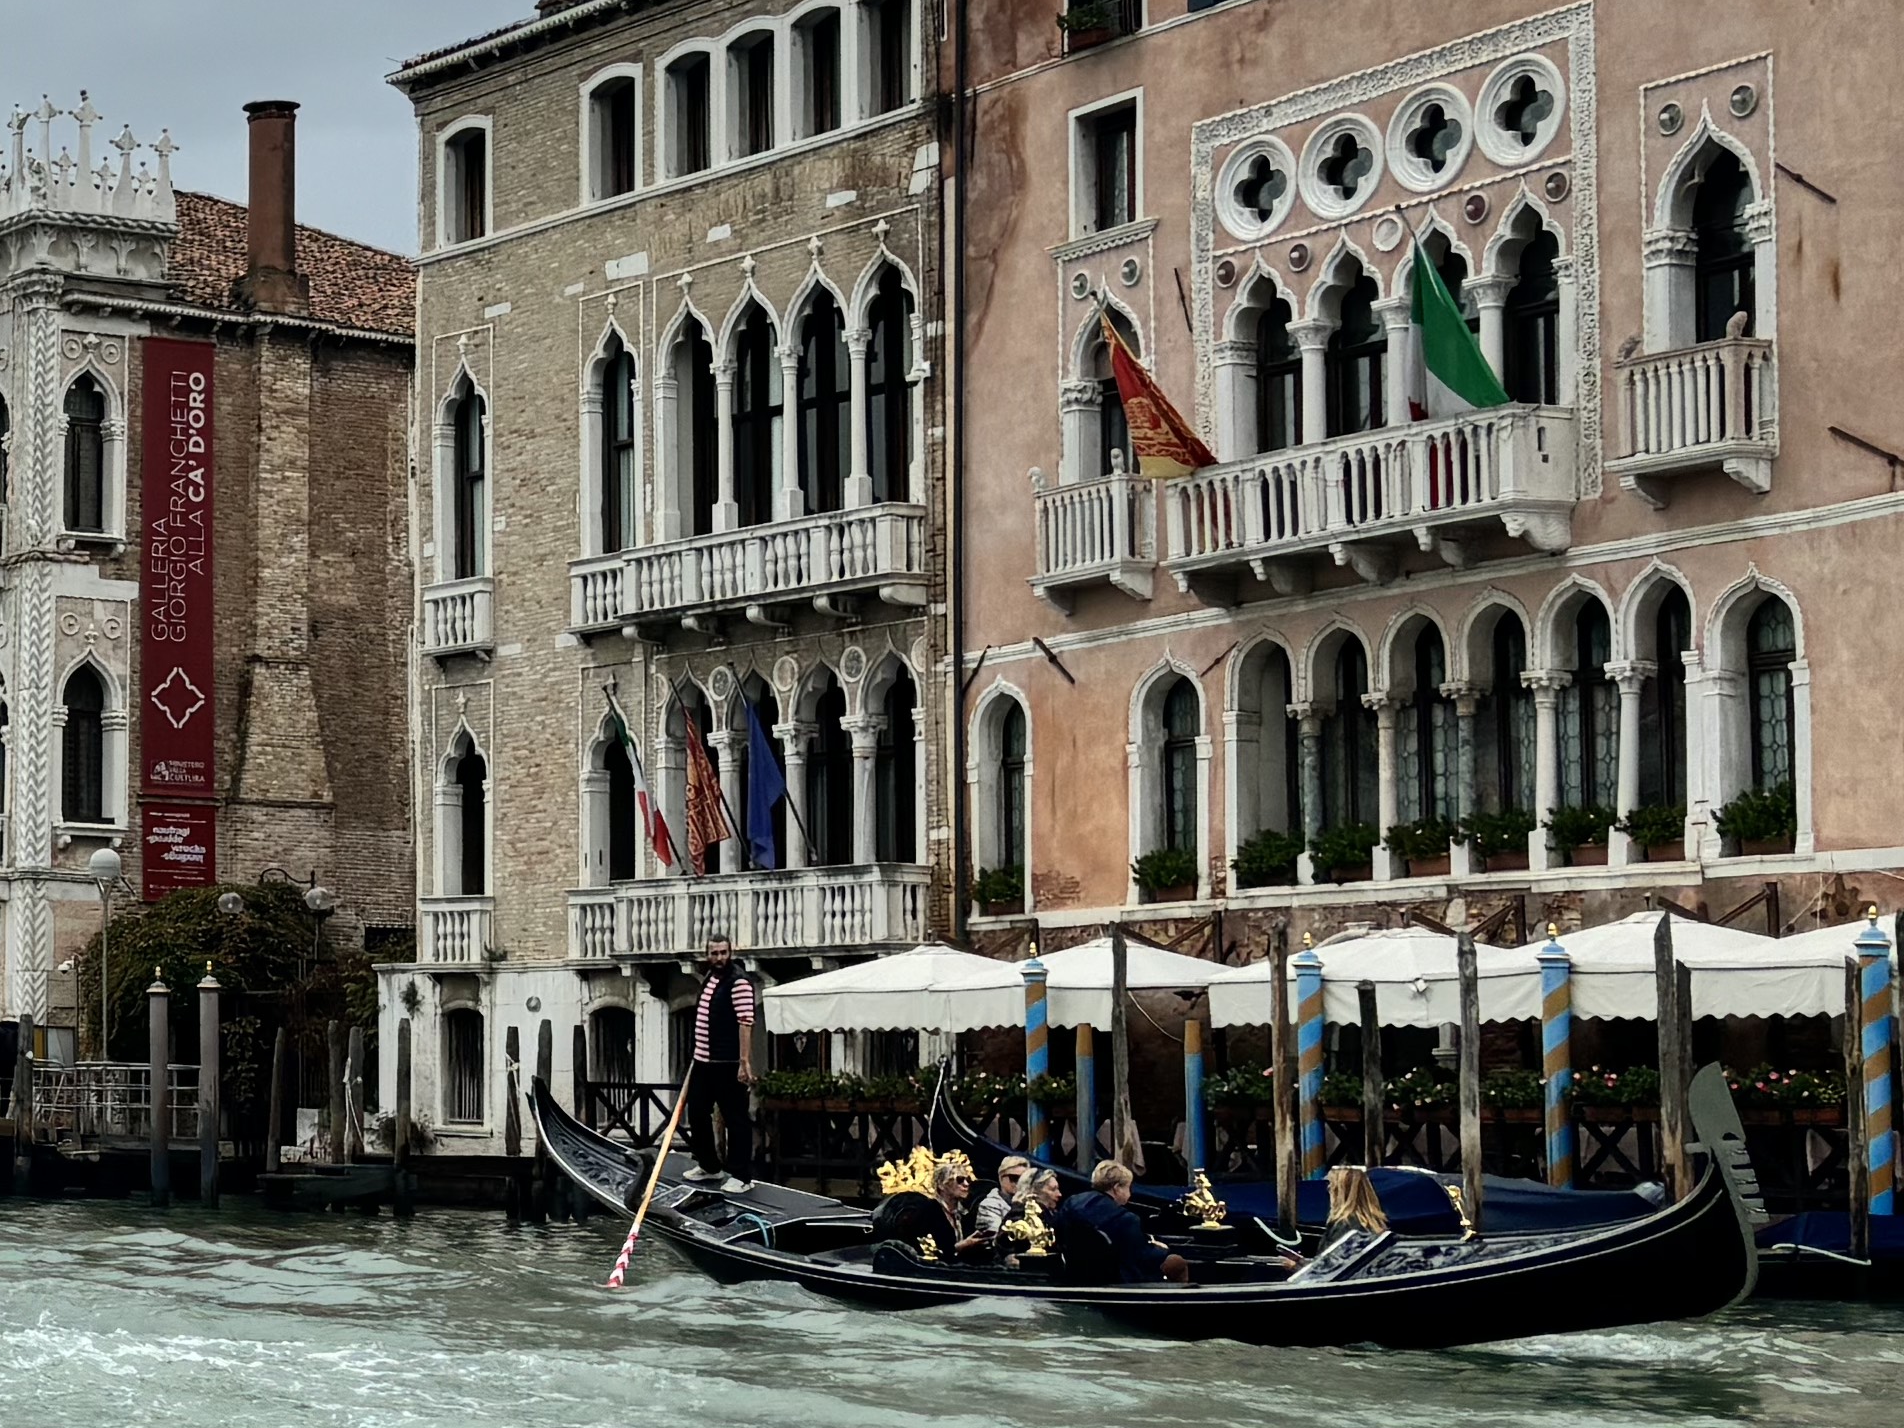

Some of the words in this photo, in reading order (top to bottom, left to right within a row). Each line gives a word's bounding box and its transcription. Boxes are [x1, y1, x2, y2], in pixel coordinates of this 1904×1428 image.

[169, 371, 188, 527] FRANCHETTI
[188, 372, 206, 453] D'ORO
[188, 460, 205, 503] CA'
[151, 517, 168, 641] GALLERIA
[188, 509, 205, 575] ALLA
[169, 536, 187, 642] GIORGIO
